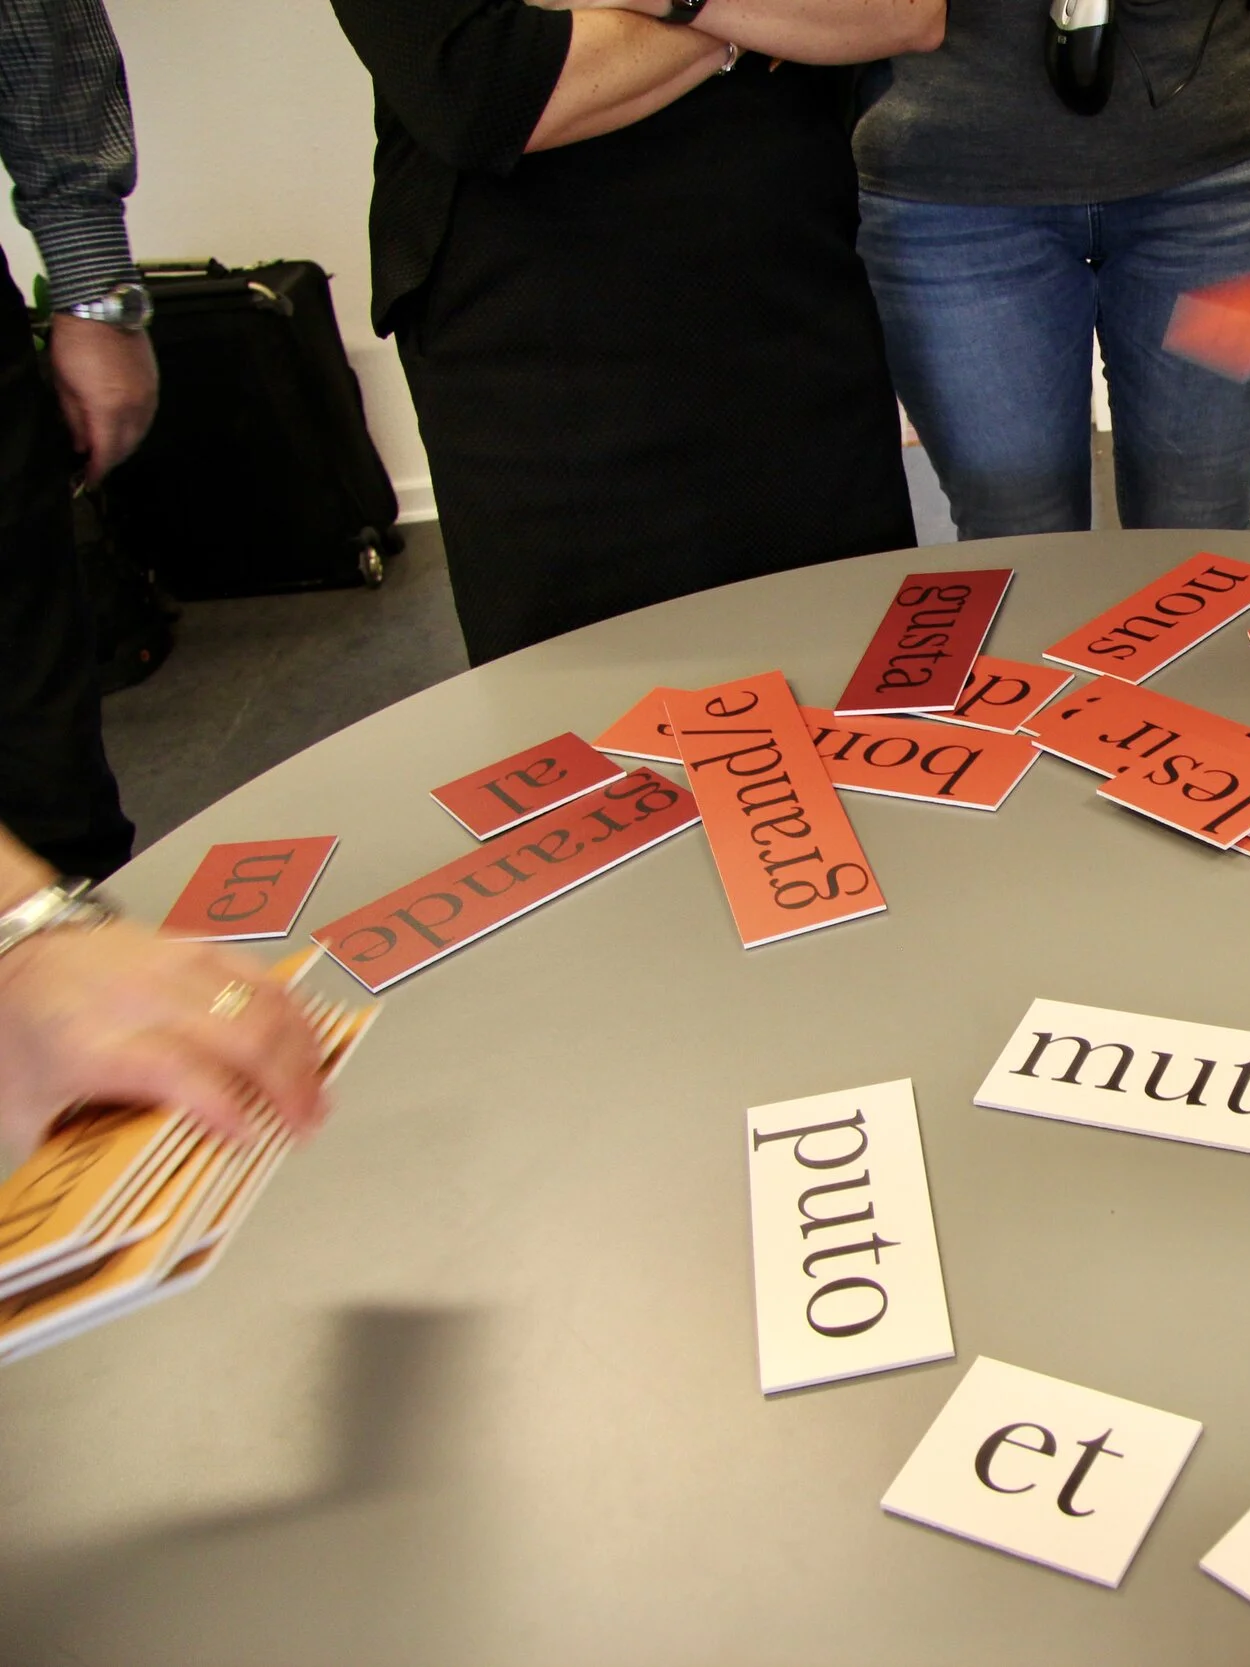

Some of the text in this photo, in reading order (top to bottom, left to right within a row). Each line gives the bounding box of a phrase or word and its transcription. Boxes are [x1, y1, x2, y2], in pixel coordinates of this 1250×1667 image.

[875, 584, 972, 694] gusta
[1086, 564, 1250, 663] nous
[478, 755, 568, 818] al
[680, 690, 870, 910] grand/e
[206, 847, 295, 924] en
[339, 770, 680, 963] grande
[752, 1107, 903, 1340] puto
[972, 1418, 1125, 1520] et
